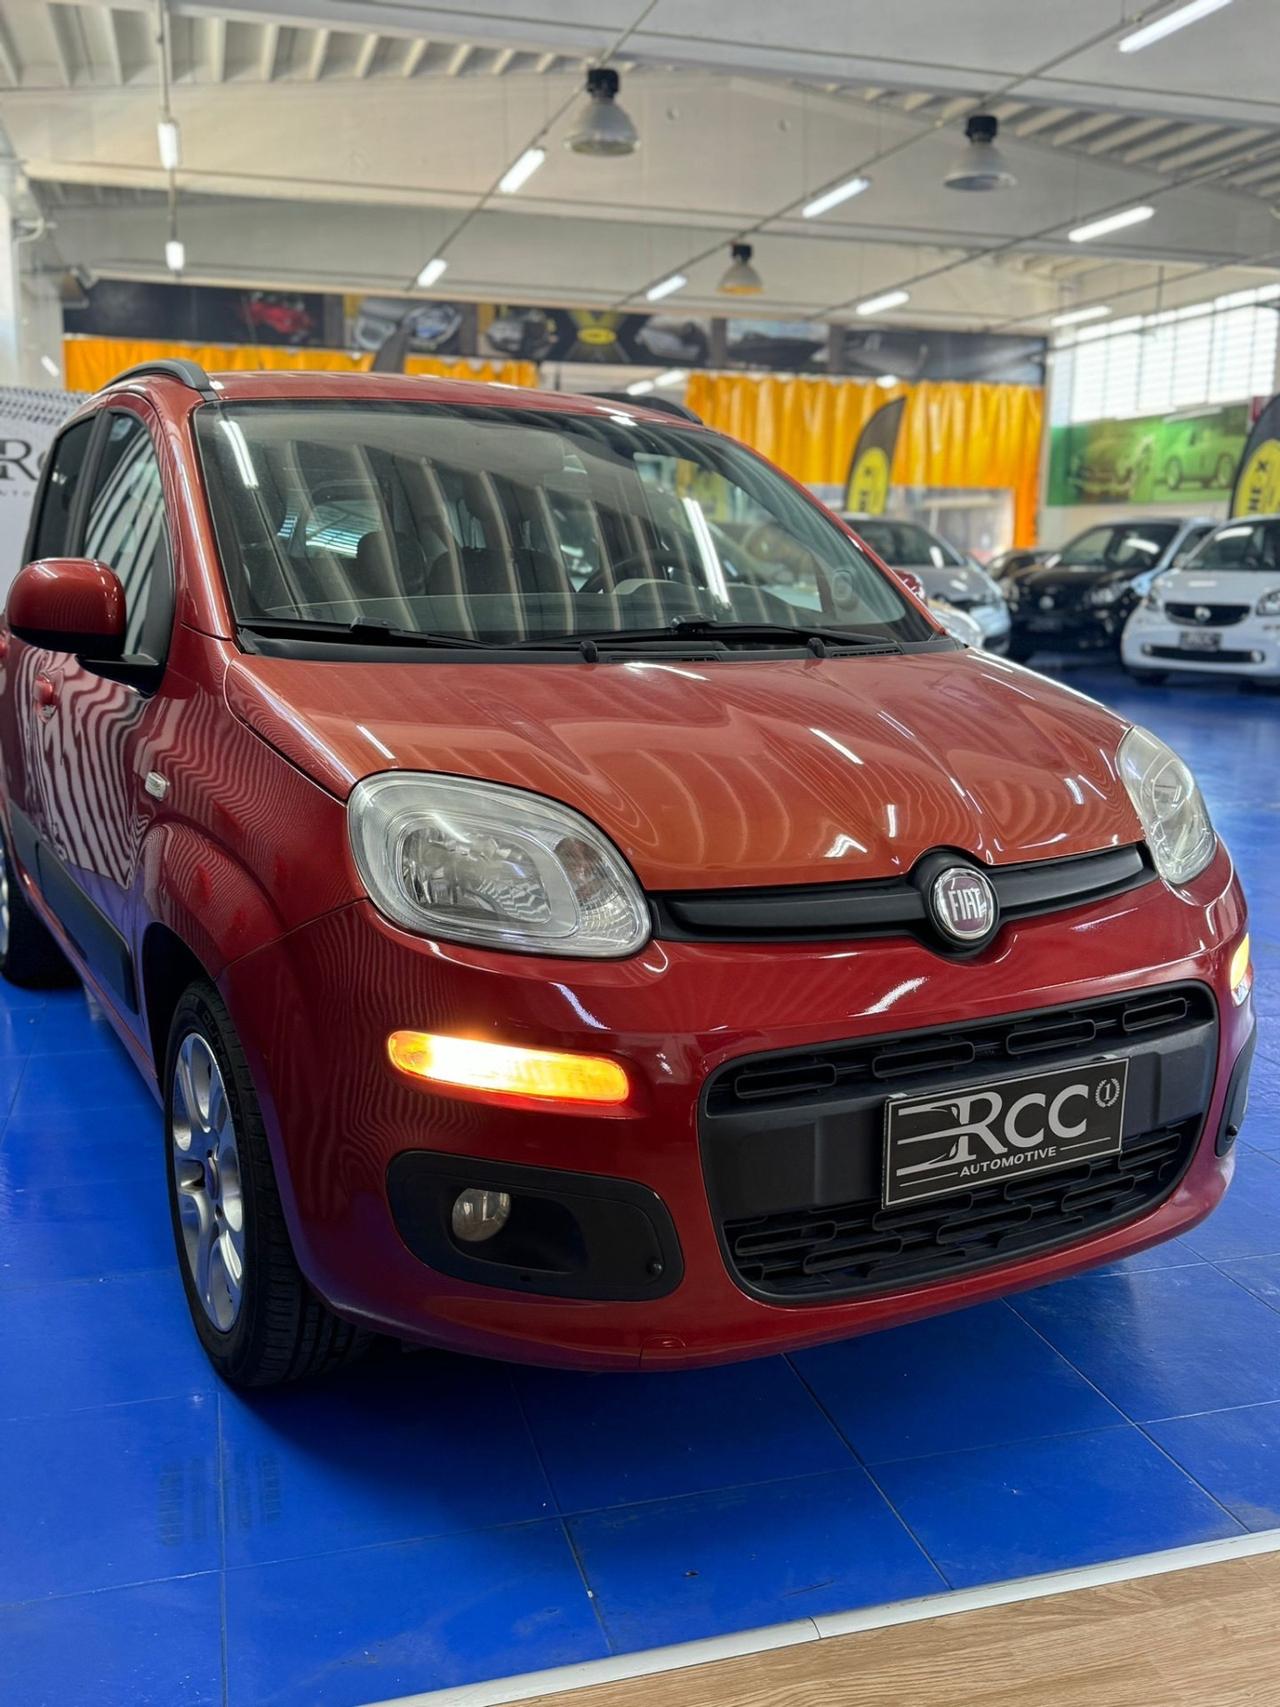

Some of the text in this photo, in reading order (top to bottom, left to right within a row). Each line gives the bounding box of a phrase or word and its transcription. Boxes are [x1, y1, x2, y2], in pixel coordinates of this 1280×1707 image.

[948, 888, 982, 921] FIAT
[949, 1083, 1111, 1160] RCC 1
[959, 1146, 1057, 1178] AUTOMOTIVE
